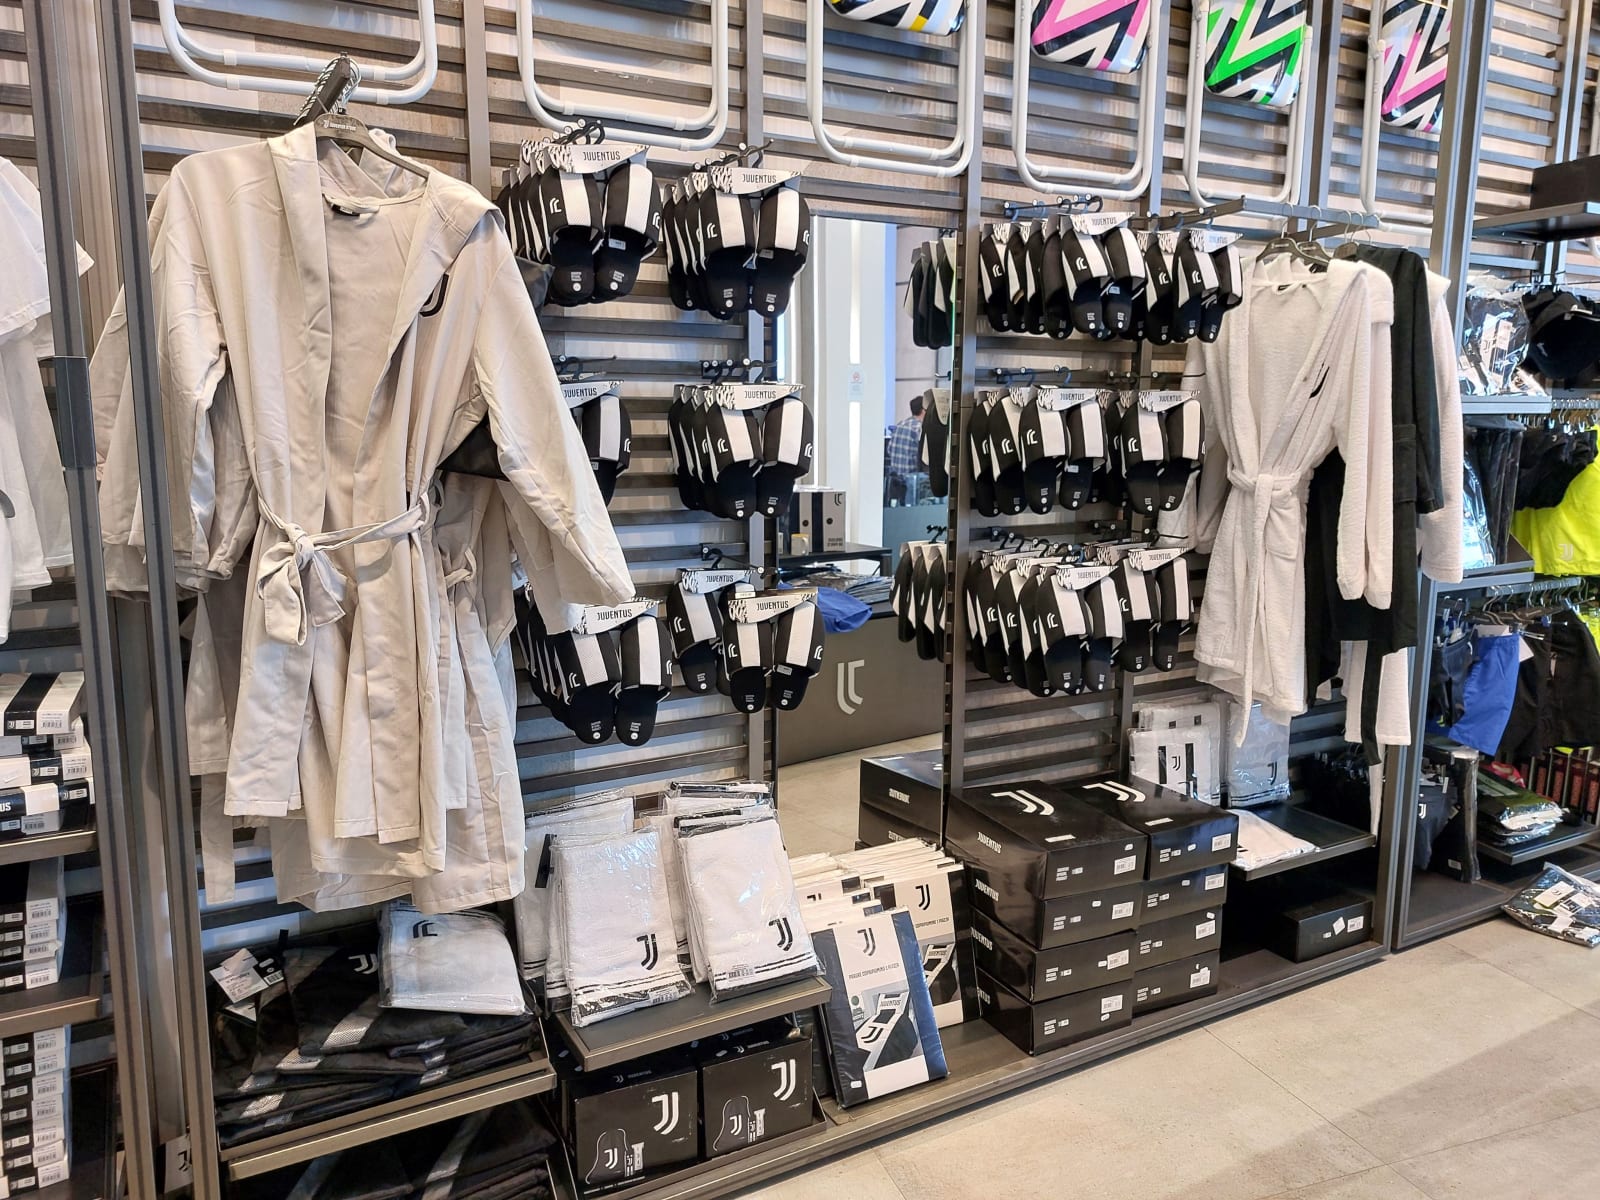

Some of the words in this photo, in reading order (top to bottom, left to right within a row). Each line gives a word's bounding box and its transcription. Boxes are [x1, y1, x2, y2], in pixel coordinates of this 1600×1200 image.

[582, 150, 621, 161] JUVENTUS
[742, 173, 777, 184] JUVENTUS
[563, 387, 598, 398] JUVENTUS
[744, 390, 777, 400] JUVENTUS
[1060, 392, 1085, 401] JUVENTUS
[1148, 552, 1172, 561] JUVENTUS
[705, 574, 734, 583] JUVENTUS
[756, 600, 789, 611] JUVENTUS
[596, 608, 633, 621] JUVENTUS
[977, 831, 1002, 854] JUVENTUS
